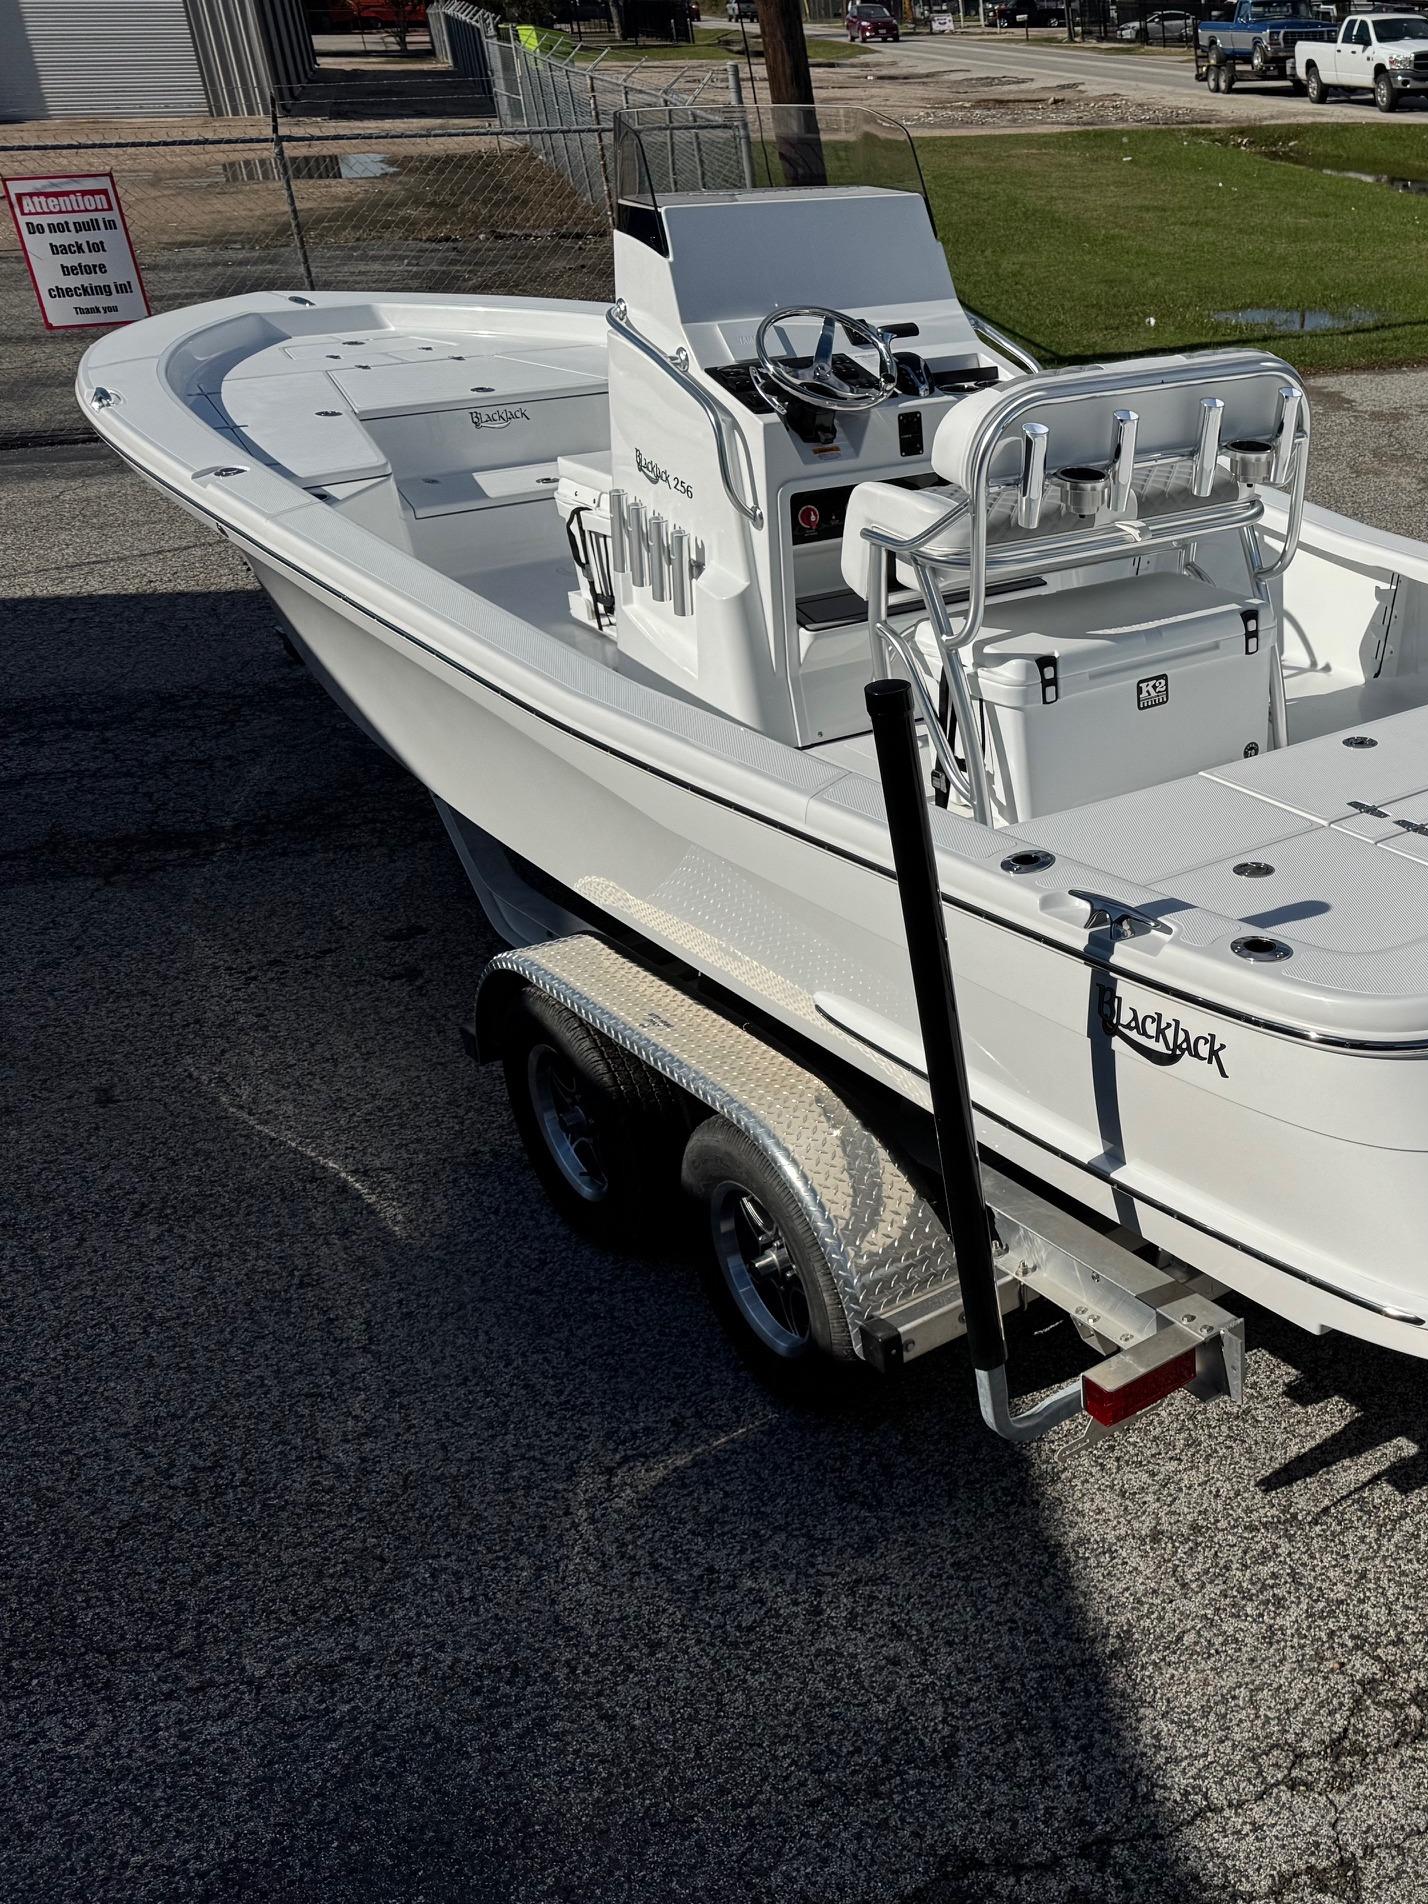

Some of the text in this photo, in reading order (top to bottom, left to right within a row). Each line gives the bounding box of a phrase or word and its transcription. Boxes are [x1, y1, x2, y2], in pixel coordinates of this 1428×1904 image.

[21, 193, 109, 213] Attention
[25, 217, 118, 235] Do not pull in
[49, 240, 107, 255] back lot
[60, 262, 108, 277] before
[48, 281, 134, 299] checking in!
[73, 305, 119, 316] Thank you
[673, 476, 694, 499] 256
[1139, 679, 1167, 698] K2
